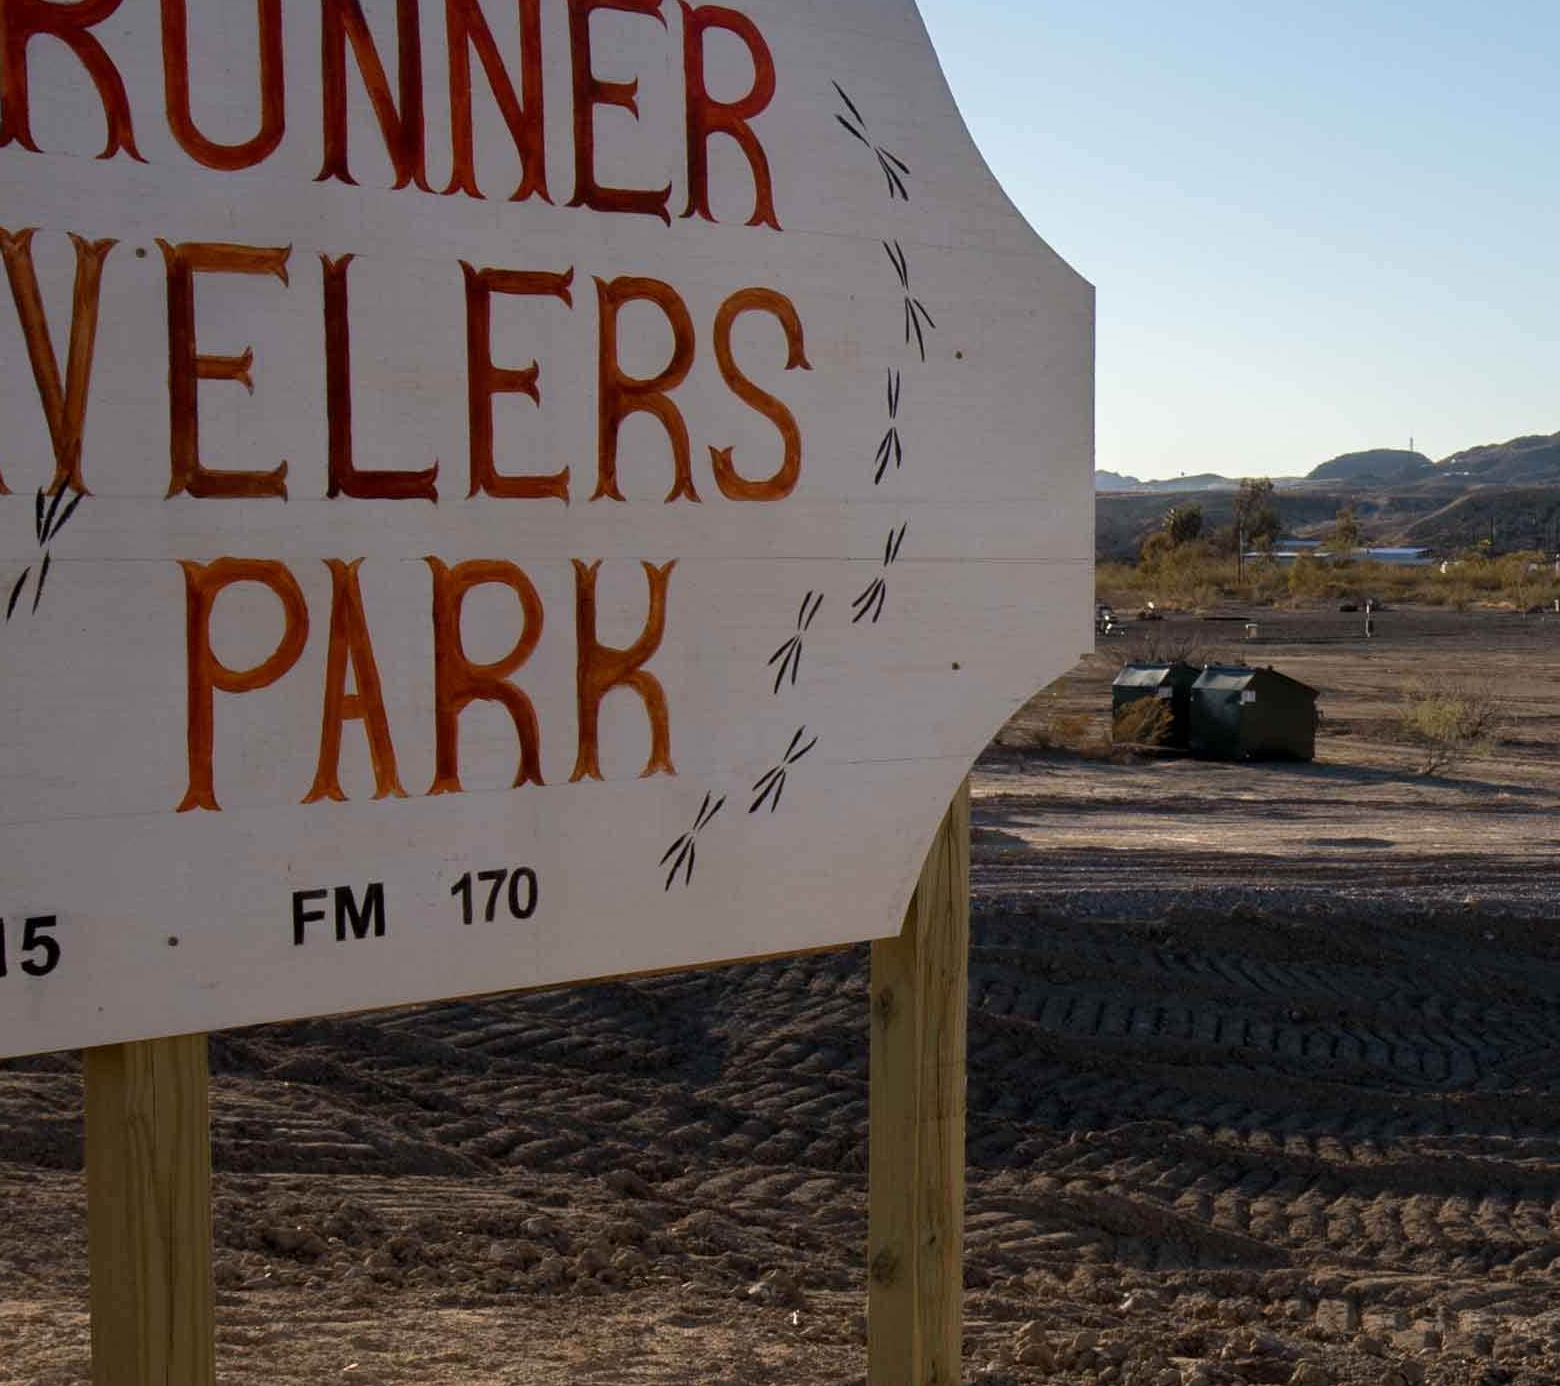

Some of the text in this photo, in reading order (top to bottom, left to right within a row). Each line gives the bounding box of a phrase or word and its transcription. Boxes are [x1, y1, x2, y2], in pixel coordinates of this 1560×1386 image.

[175, 554, 679, 814] PARK
[292, 883, 387, 946] FM
[450, 867, 539, 926] 170
